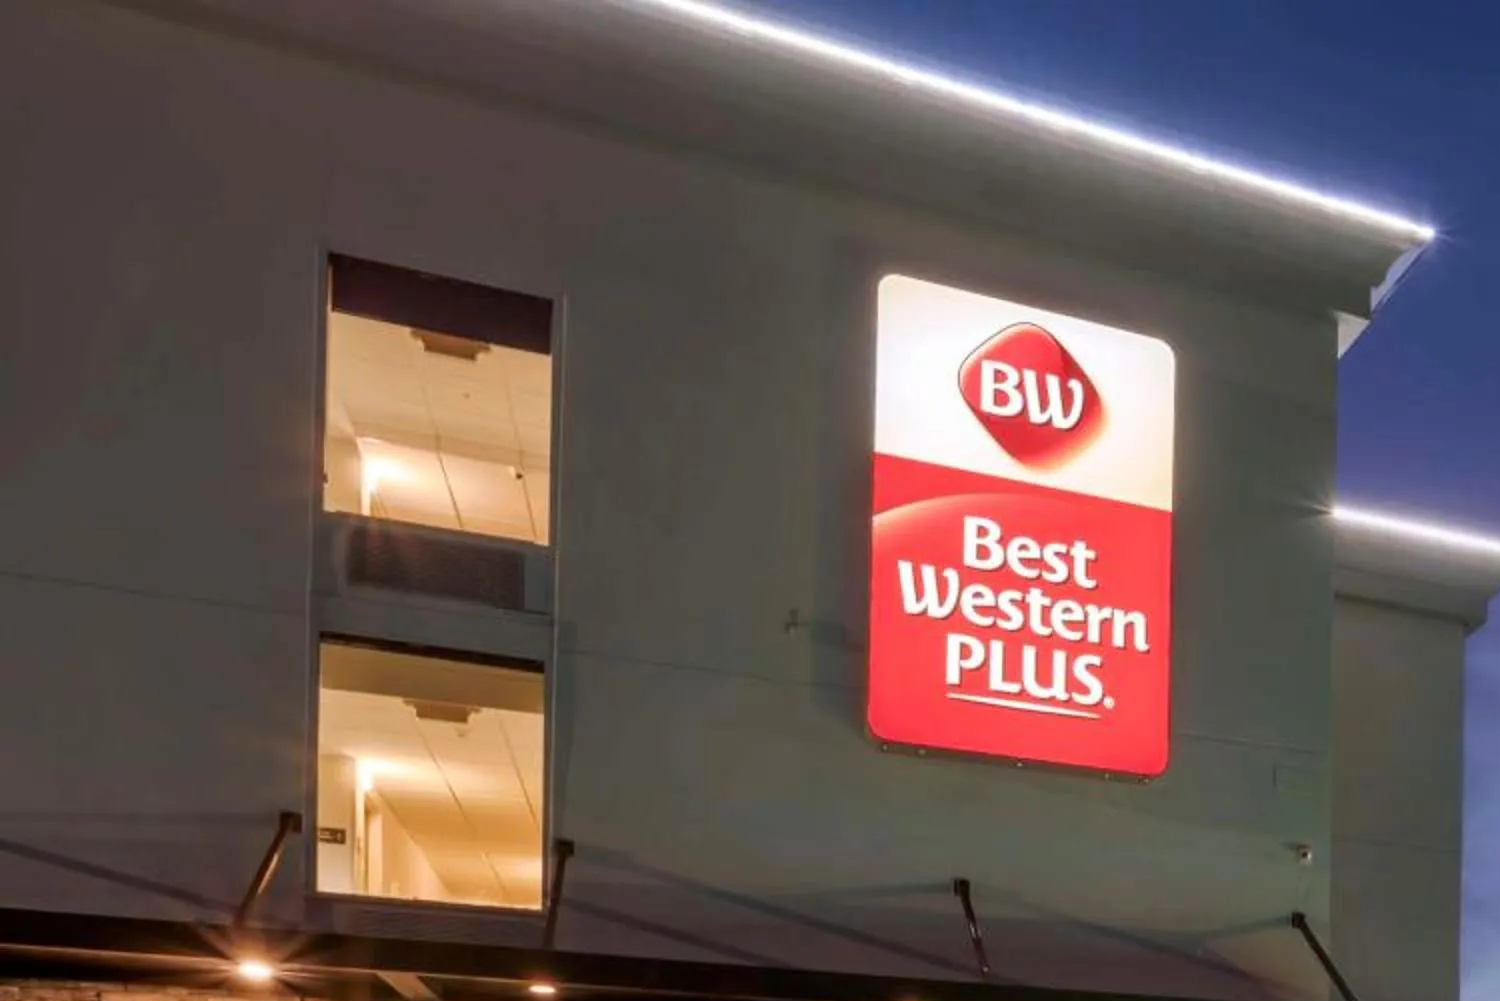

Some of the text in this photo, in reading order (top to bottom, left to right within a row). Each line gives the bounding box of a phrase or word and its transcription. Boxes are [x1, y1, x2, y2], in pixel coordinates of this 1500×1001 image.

[980, 359, 1084, 430] BW
[963, 515, 1097, 589] Best
[897, 559, 1149, 652] Western
